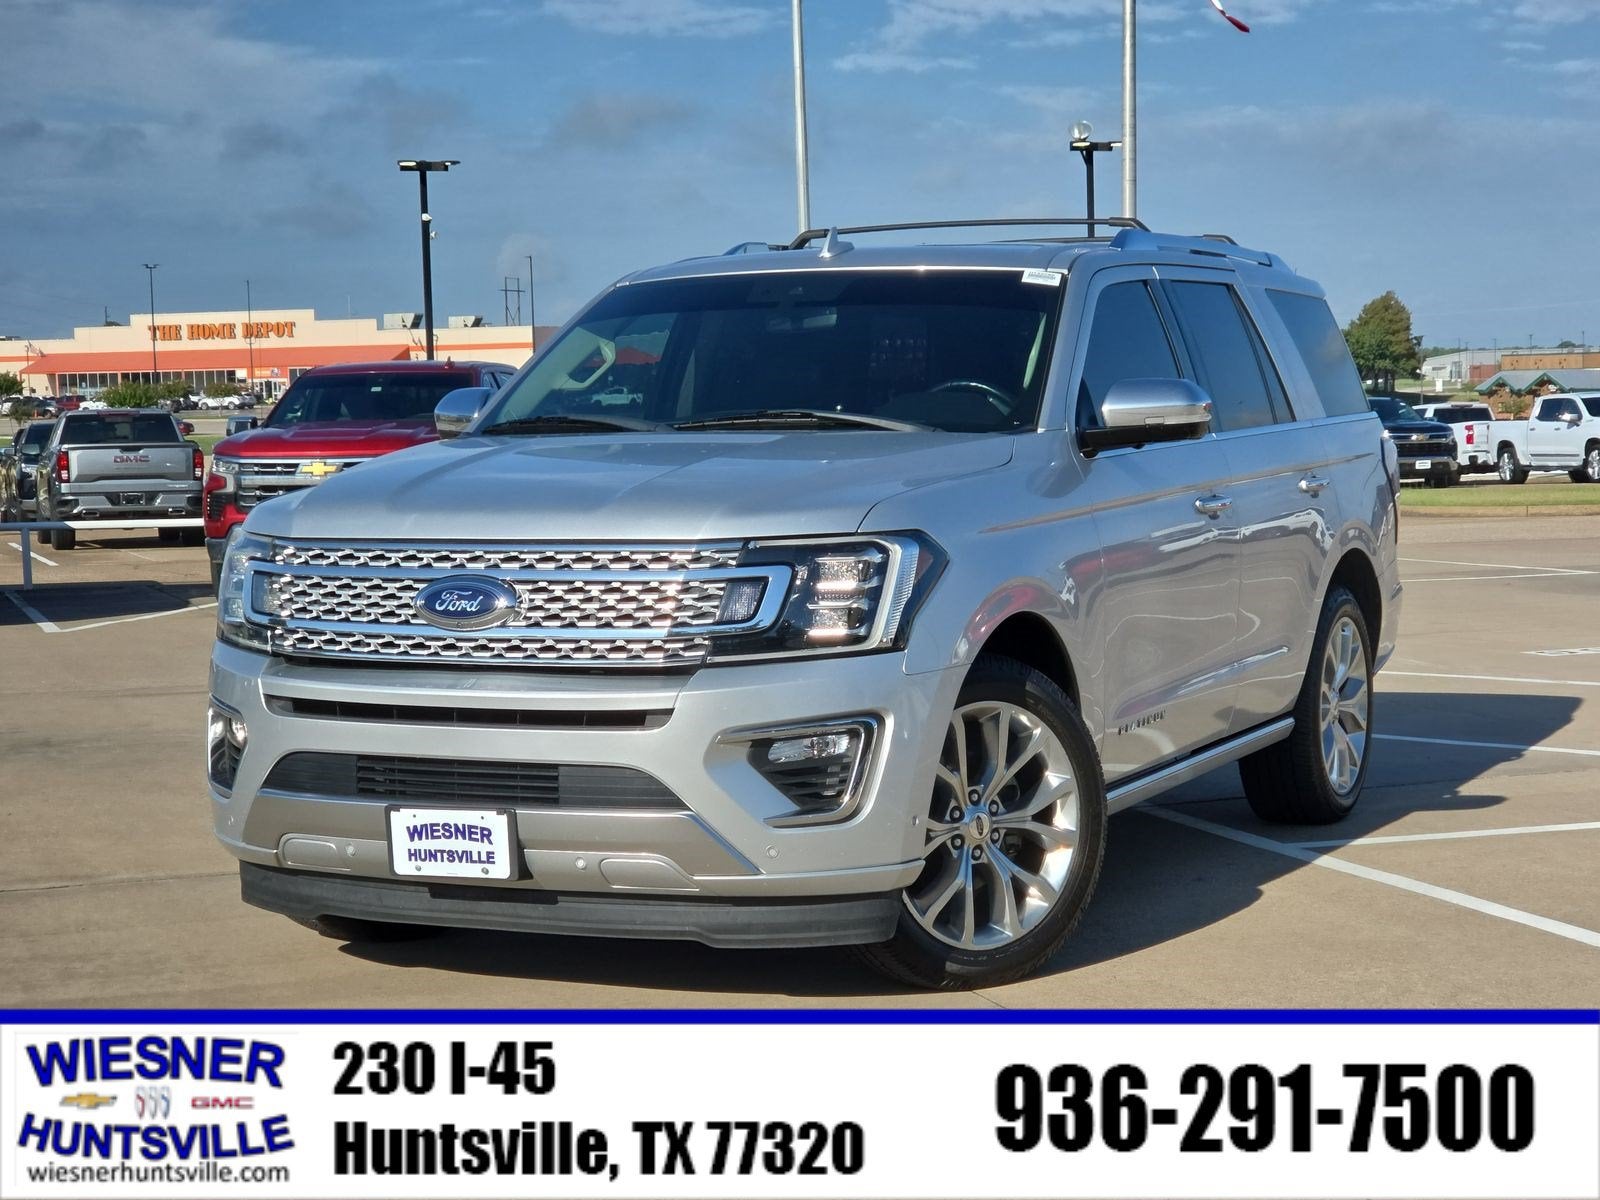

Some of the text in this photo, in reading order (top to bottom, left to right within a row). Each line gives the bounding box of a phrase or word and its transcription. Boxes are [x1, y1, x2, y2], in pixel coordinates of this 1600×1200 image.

[148, 321, 296, 341] THE HOME DEPOT
[113, 455, 150, 463] GMC
[435, 589, 483, 612] Ford
[406, 822, 494, 846] WIESNER
[407, 848, 496, 865] HUNTSVILLE
